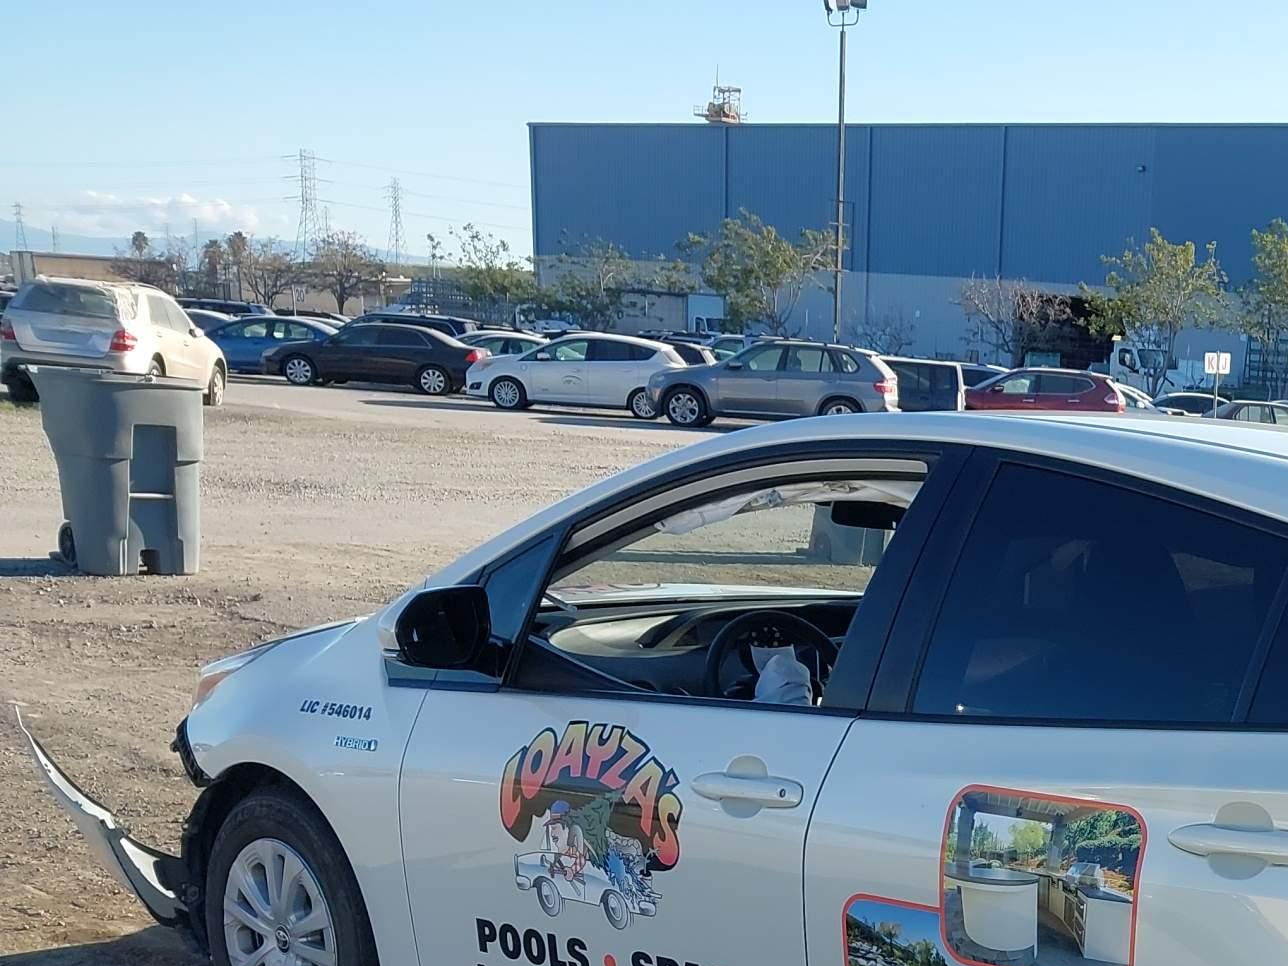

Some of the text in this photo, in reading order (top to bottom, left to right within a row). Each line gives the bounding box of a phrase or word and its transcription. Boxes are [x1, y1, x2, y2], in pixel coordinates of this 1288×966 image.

[1207, 356, 1215, 370] K
[300, 700, 372, 720] LIC #546014
[500, 720, 683, 872] LOAYZA'S
